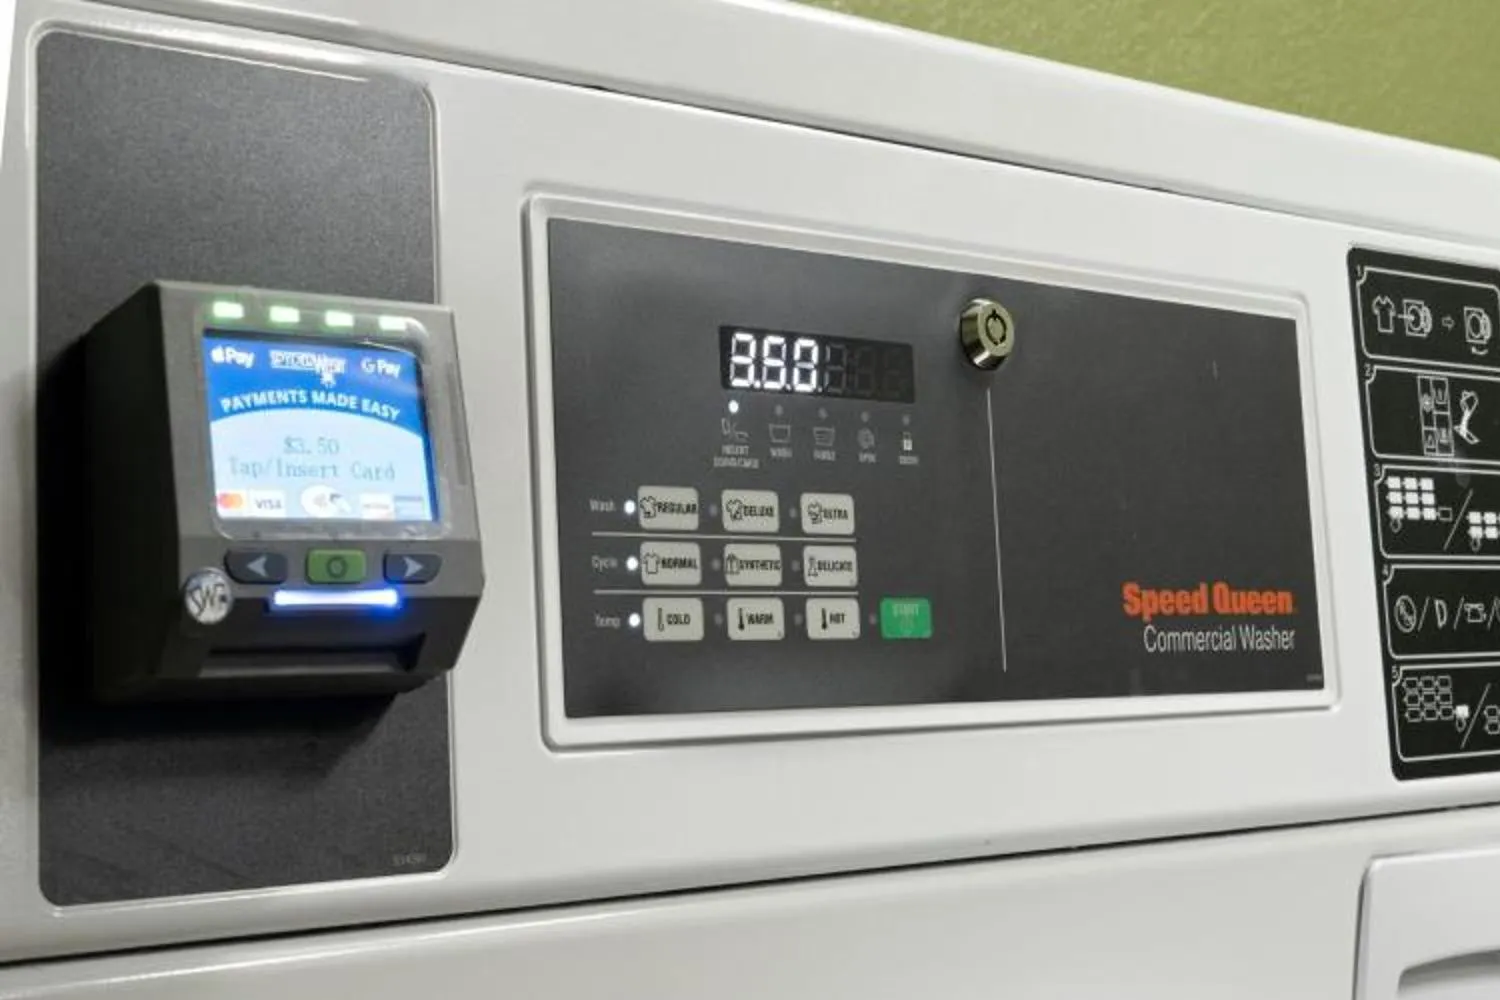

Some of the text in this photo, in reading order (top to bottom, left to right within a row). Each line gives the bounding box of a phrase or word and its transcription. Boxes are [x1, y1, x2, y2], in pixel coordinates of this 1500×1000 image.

[226, 346, 255, 369] Pay
[377, 358, 401, 379] Pay
[220, 389, 401, 421] PAYMENTS MADE EASY
[283, 436, 340, 456] $3.50
[228, 456, 396, 481] Tap/Insert Card
[255, 498, 282, 510] VISA
[590, 499, 616, 512] Wash
[657, 501, 697, 515] REGULAR
[591, 555, 618, 572] Cycle
[660, 557, 698, 570] NORMAL
[739, 559, 782, 571] SYNTHETIC
[817, 559, 853, 572] DELICATE
[1122, 581, 1293, 622] Speed Queen
[595, 614, 621, 630] Temp
[665, 613, 691, 626] COLD
[746, 612, 774, 625] WARM
[829, 612, 847, 624] HOT
[1143, 624, 1296, 652] Commercial Washer
